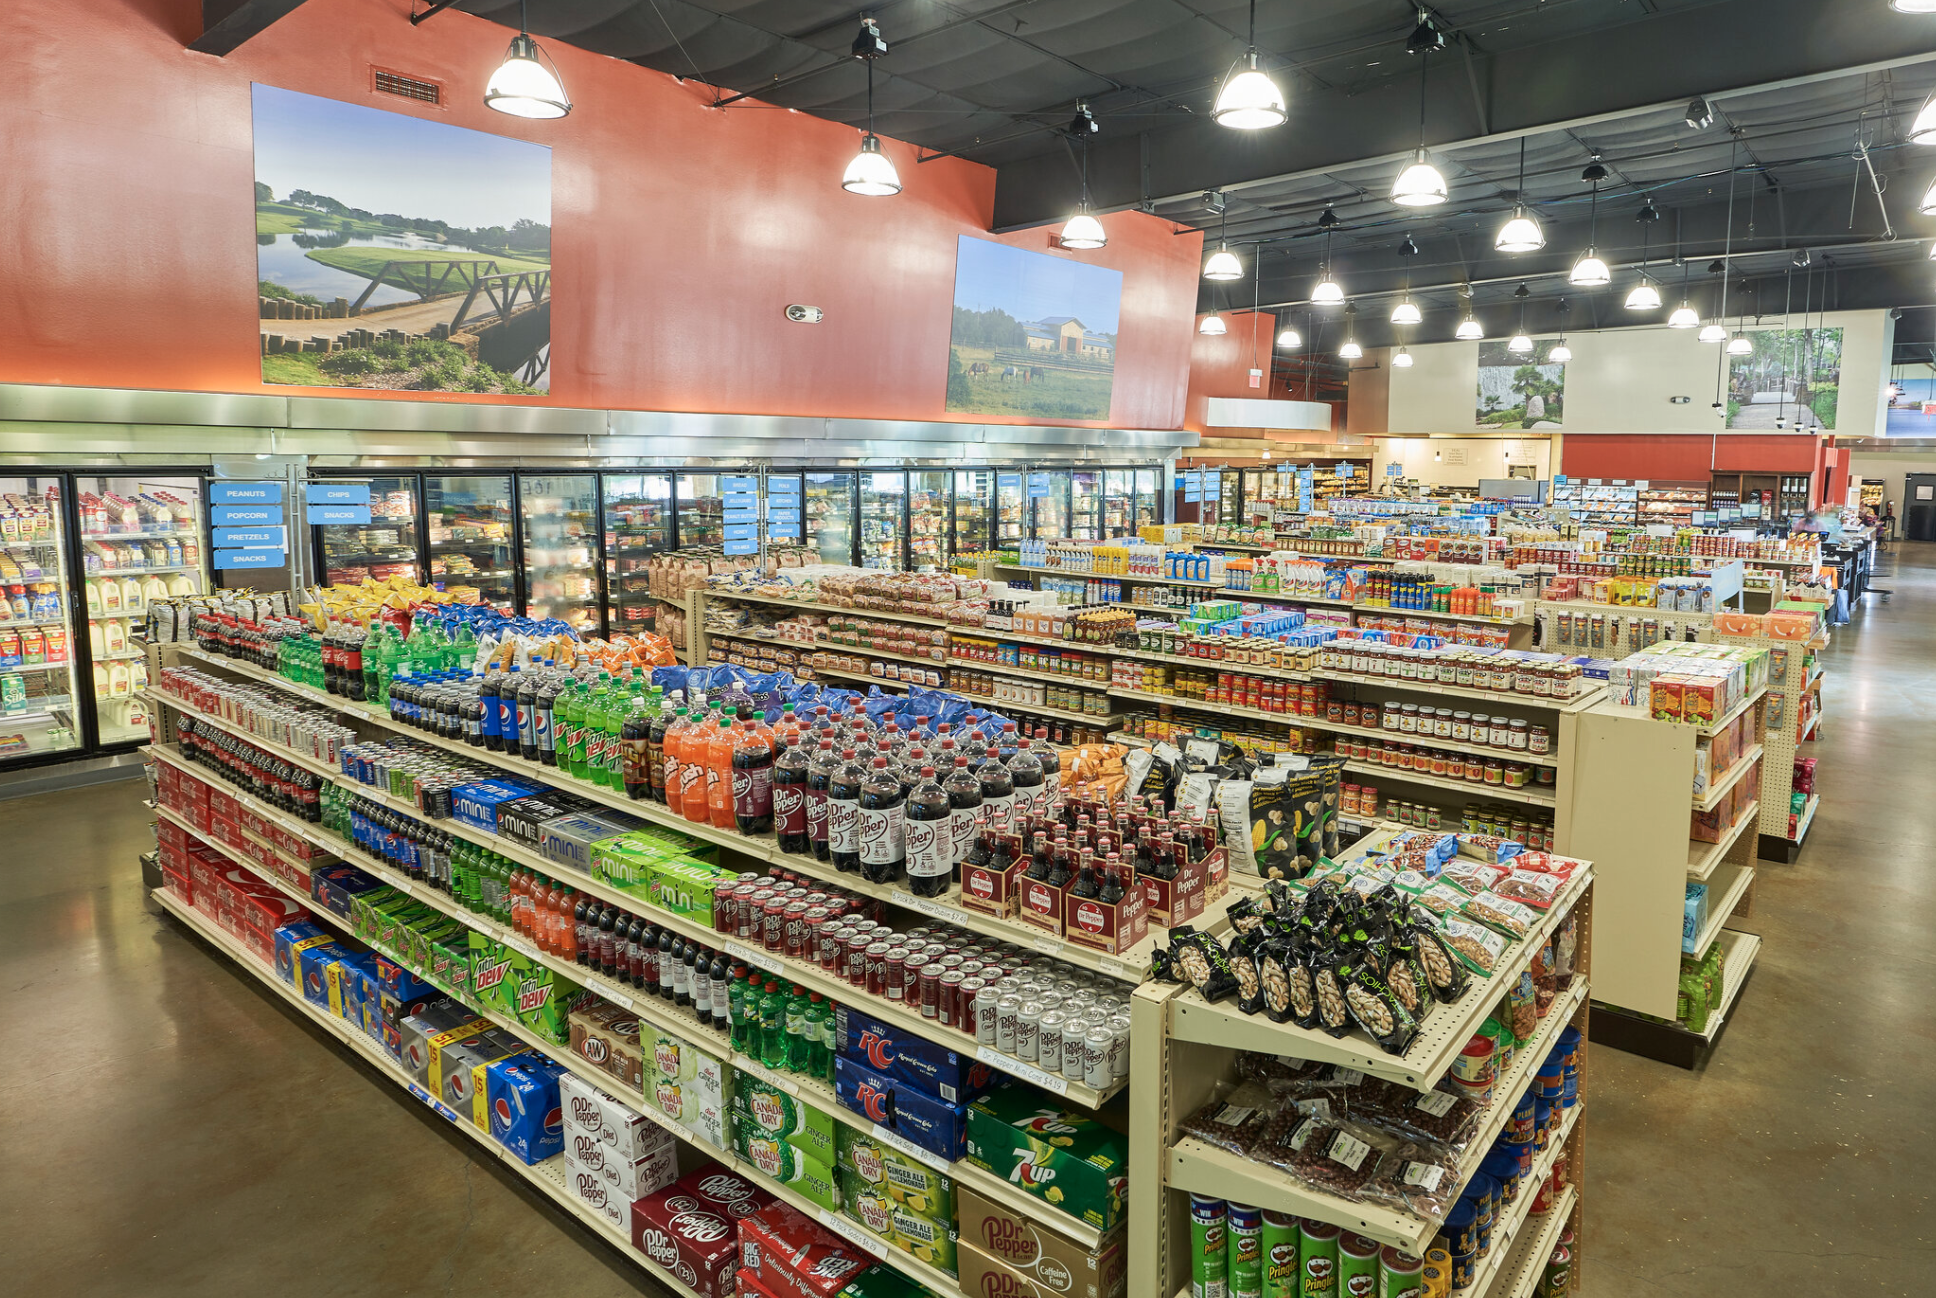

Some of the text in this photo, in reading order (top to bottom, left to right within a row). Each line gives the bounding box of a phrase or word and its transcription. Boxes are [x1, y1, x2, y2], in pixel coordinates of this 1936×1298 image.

[233, 555, 267, 563] SNACKS
[4, 691, 26, 706] Silk
[460, 798, 486, 820] mini
[505, 814, 530, 838] mini
[283, 834, 298, 856] Coke
[550, 835, 578, 860] mini
[284, 864, 299, 885] Coke
[602, 857, 632, 883] mini
[1176, 868, 1200, 894] Dr Pepper
[661, 884, 694, 912] mini
[917, 901, 934, 912] Pepper
[1122, 890, 1144, 918] Dr Pepper
[1085, 913, 1102, 925] Pepper
[429, 1044, 438, 1061] 15
[858, 1030, 896, 1070] RC
[662, 1062, 676, 1074] DRY
[704, 1068, 715, 1078] diet
[898, 1052, 914, 1062] Royal
[912, 1059, 927, 1069] Crown
[926, 1064, 938, 1073] Cola
[982, 1052, 1062, 1090] Dr. Pepper Mini Cans $4.19
[473, 1075, 484, 1094] 15
[698, 1071, 720, 1090] GINGER
[572, 1097, 600, 1126] Dr Pepper
[656, 1090, 683, 1114] CANADA DRY
[751, 1098, 784, 1126] CANADA DRY
[856, 1082, 888, 1122] RC
[700, 1112, 720, 1128] GINGER
[704, 1108, 716, 1118] diet
[894, 1107, 910, 1117] Royal
[922, 1120, 932, 1128] Cola
[1012, 1109, 1078, 1134] 7UP
[539, 1137, 560, 1145] pepsi
[603, 1128, 615, 1140] Diet
[805, 1125, 832, 1150] GINGER ALE
[574, 1136, 602, 1164] Dr Pepper
[748, 1142, 782, 1173] CANADA DRY
[606, 1168, 617, 1180] Diet
[852, 1150, 884, 1178] CANADA DRY
[887, 1165, 924, 1182] GINGER ALE
[1010, 1148, 1056, 1184] 7UP
[576, 1173, 604, 1202] Dr Pepper
[701, 1175, 748, 1199] Dr Pepper
[804, 1172, 831, 1196] GINGER ALE
[897, 1176, 926, 1190] LEMONADE
[608, 1207, 618, 1219] Diet
[741, 1203, 753, 1212] 23
[857, 1201, 890, 1228] CANADA DRY
[1200, 1208, 1212, 1218] WIN
[894, 1216, 932, 1233] GINGER ALE
[1234, 1218, 1244, 1228] WIN
[829, 1218, 836, 1226] 12
[836, 1221, 848, 1233] Pack
[862, 1239, 878, 1252] $6.29
[904, 1226, 932, 1242] LEMONADE
[982, 1216, 1037, 1258] Dr Pepper
[643, 1229, 676, 1261] Dr Pepper
[744, 1242, 759, 1256] BIG
[744, 1254, 760, 1268] RED
[1236, 1248, 1260, 1265] Pringles
[681, 1265, 690, 1280] 23
[764, 1253, 795, 1286] Deliciously
[808, 1256, 860, 1279] BIG RED
[1040, 1266, 1068, 1280] Caffeine
[1268, 1260, 1299, 1281] Pringles
[1050, 1276, 1064, 1286] Free
[1304, 1276, 1336, 1292] Pringles
